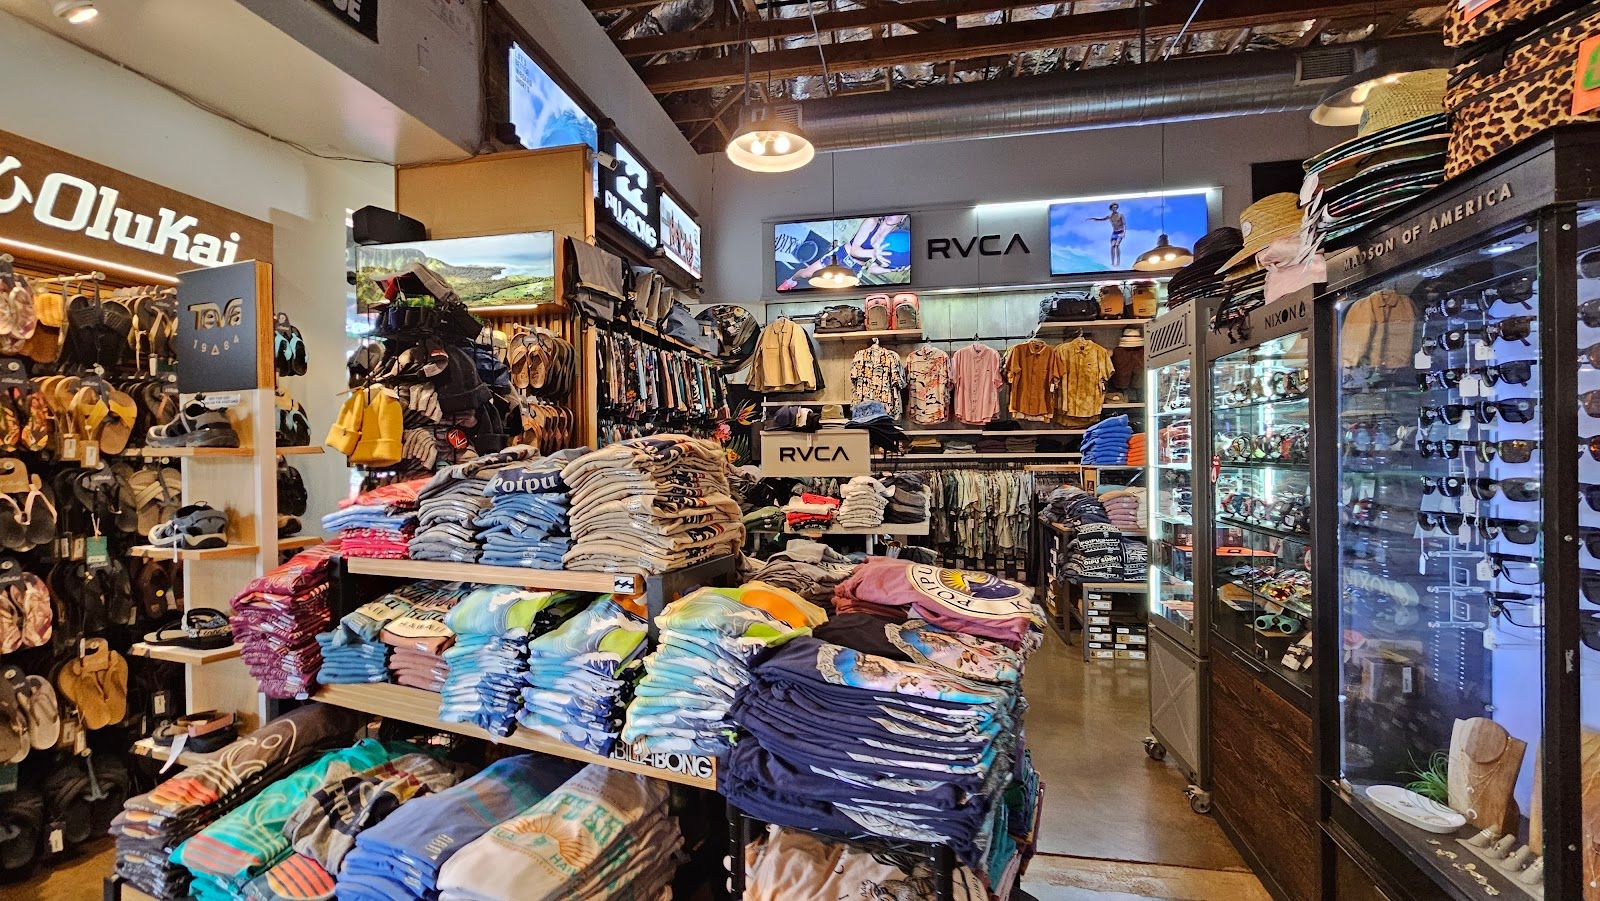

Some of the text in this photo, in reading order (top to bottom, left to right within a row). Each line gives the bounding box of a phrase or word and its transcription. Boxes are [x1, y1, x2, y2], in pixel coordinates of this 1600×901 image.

[33, 173, 240, 267] OluKai
[1344, 183, 1514, 271] MADSON OF AMERICA
[928, 234, 1030, 259] RVCA
[1265, 304, 1297, 329] NIXON
[779, 446, 849, 462] RVCA
[918, 566, 971, 607] POIPU
